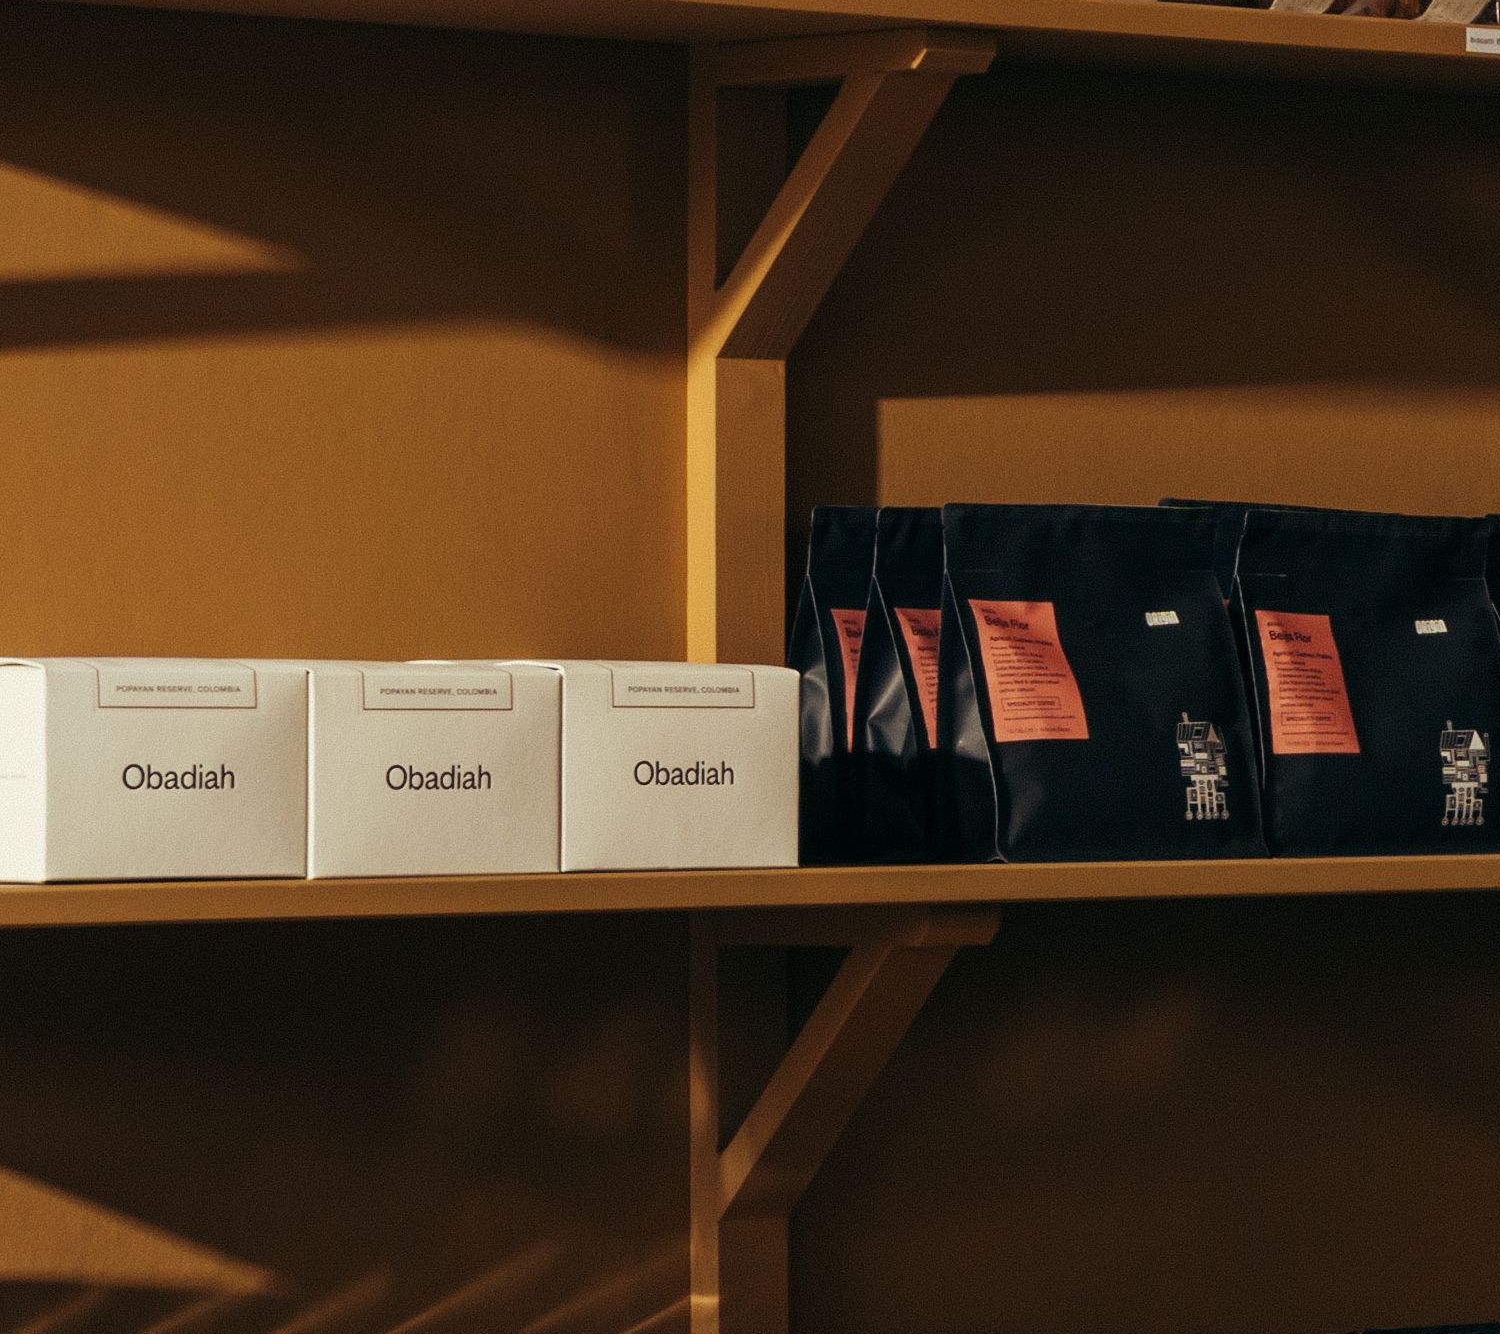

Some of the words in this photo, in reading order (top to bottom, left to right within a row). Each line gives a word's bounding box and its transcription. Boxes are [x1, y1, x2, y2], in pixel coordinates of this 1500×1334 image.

[197, 685, 241, 693] COLOMBIA
[456, 688, 497, 696] COLOMBIA
[701, 686, 740, 694] COLOMBIA
[122, 763, 236, 790] Obadiah
[386, 764, 492, 790] Obadiah
[634, 760, 735, 786] Obadiah
